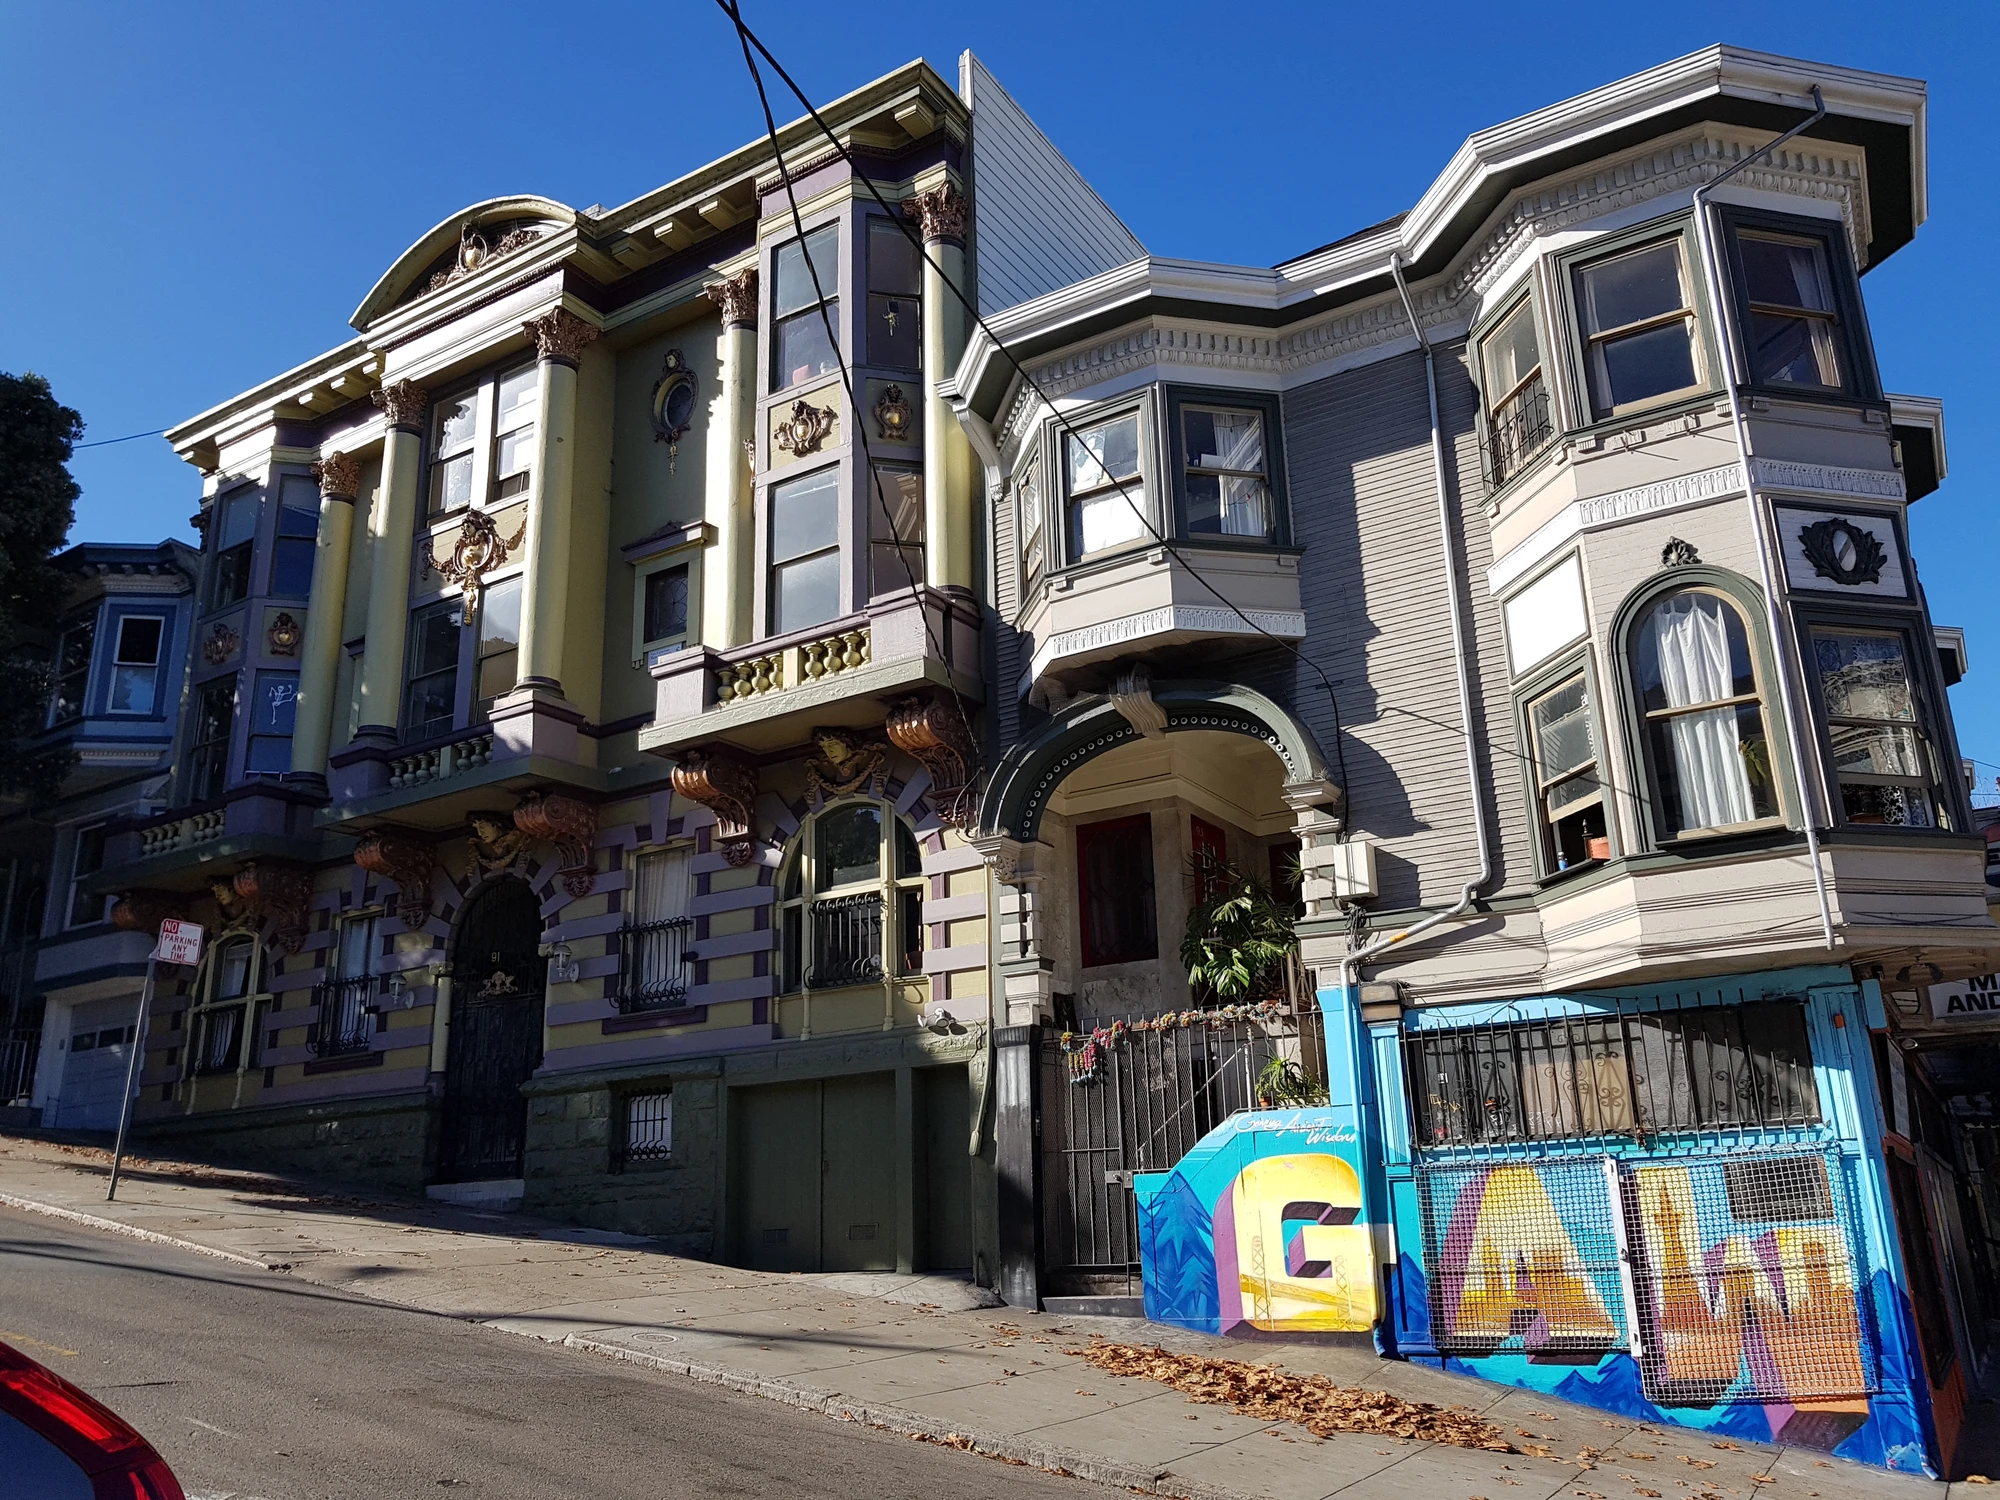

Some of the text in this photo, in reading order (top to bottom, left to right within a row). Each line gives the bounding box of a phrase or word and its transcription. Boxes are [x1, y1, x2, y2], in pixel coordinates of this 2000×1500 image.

[164, 921, 178, 933] NO
[164, 934, 198, 947] PARKING
[171, 943, 188, 953] ANY
[170, 951, 187, 960] TIME
[491, 951, 501, 962] 91
